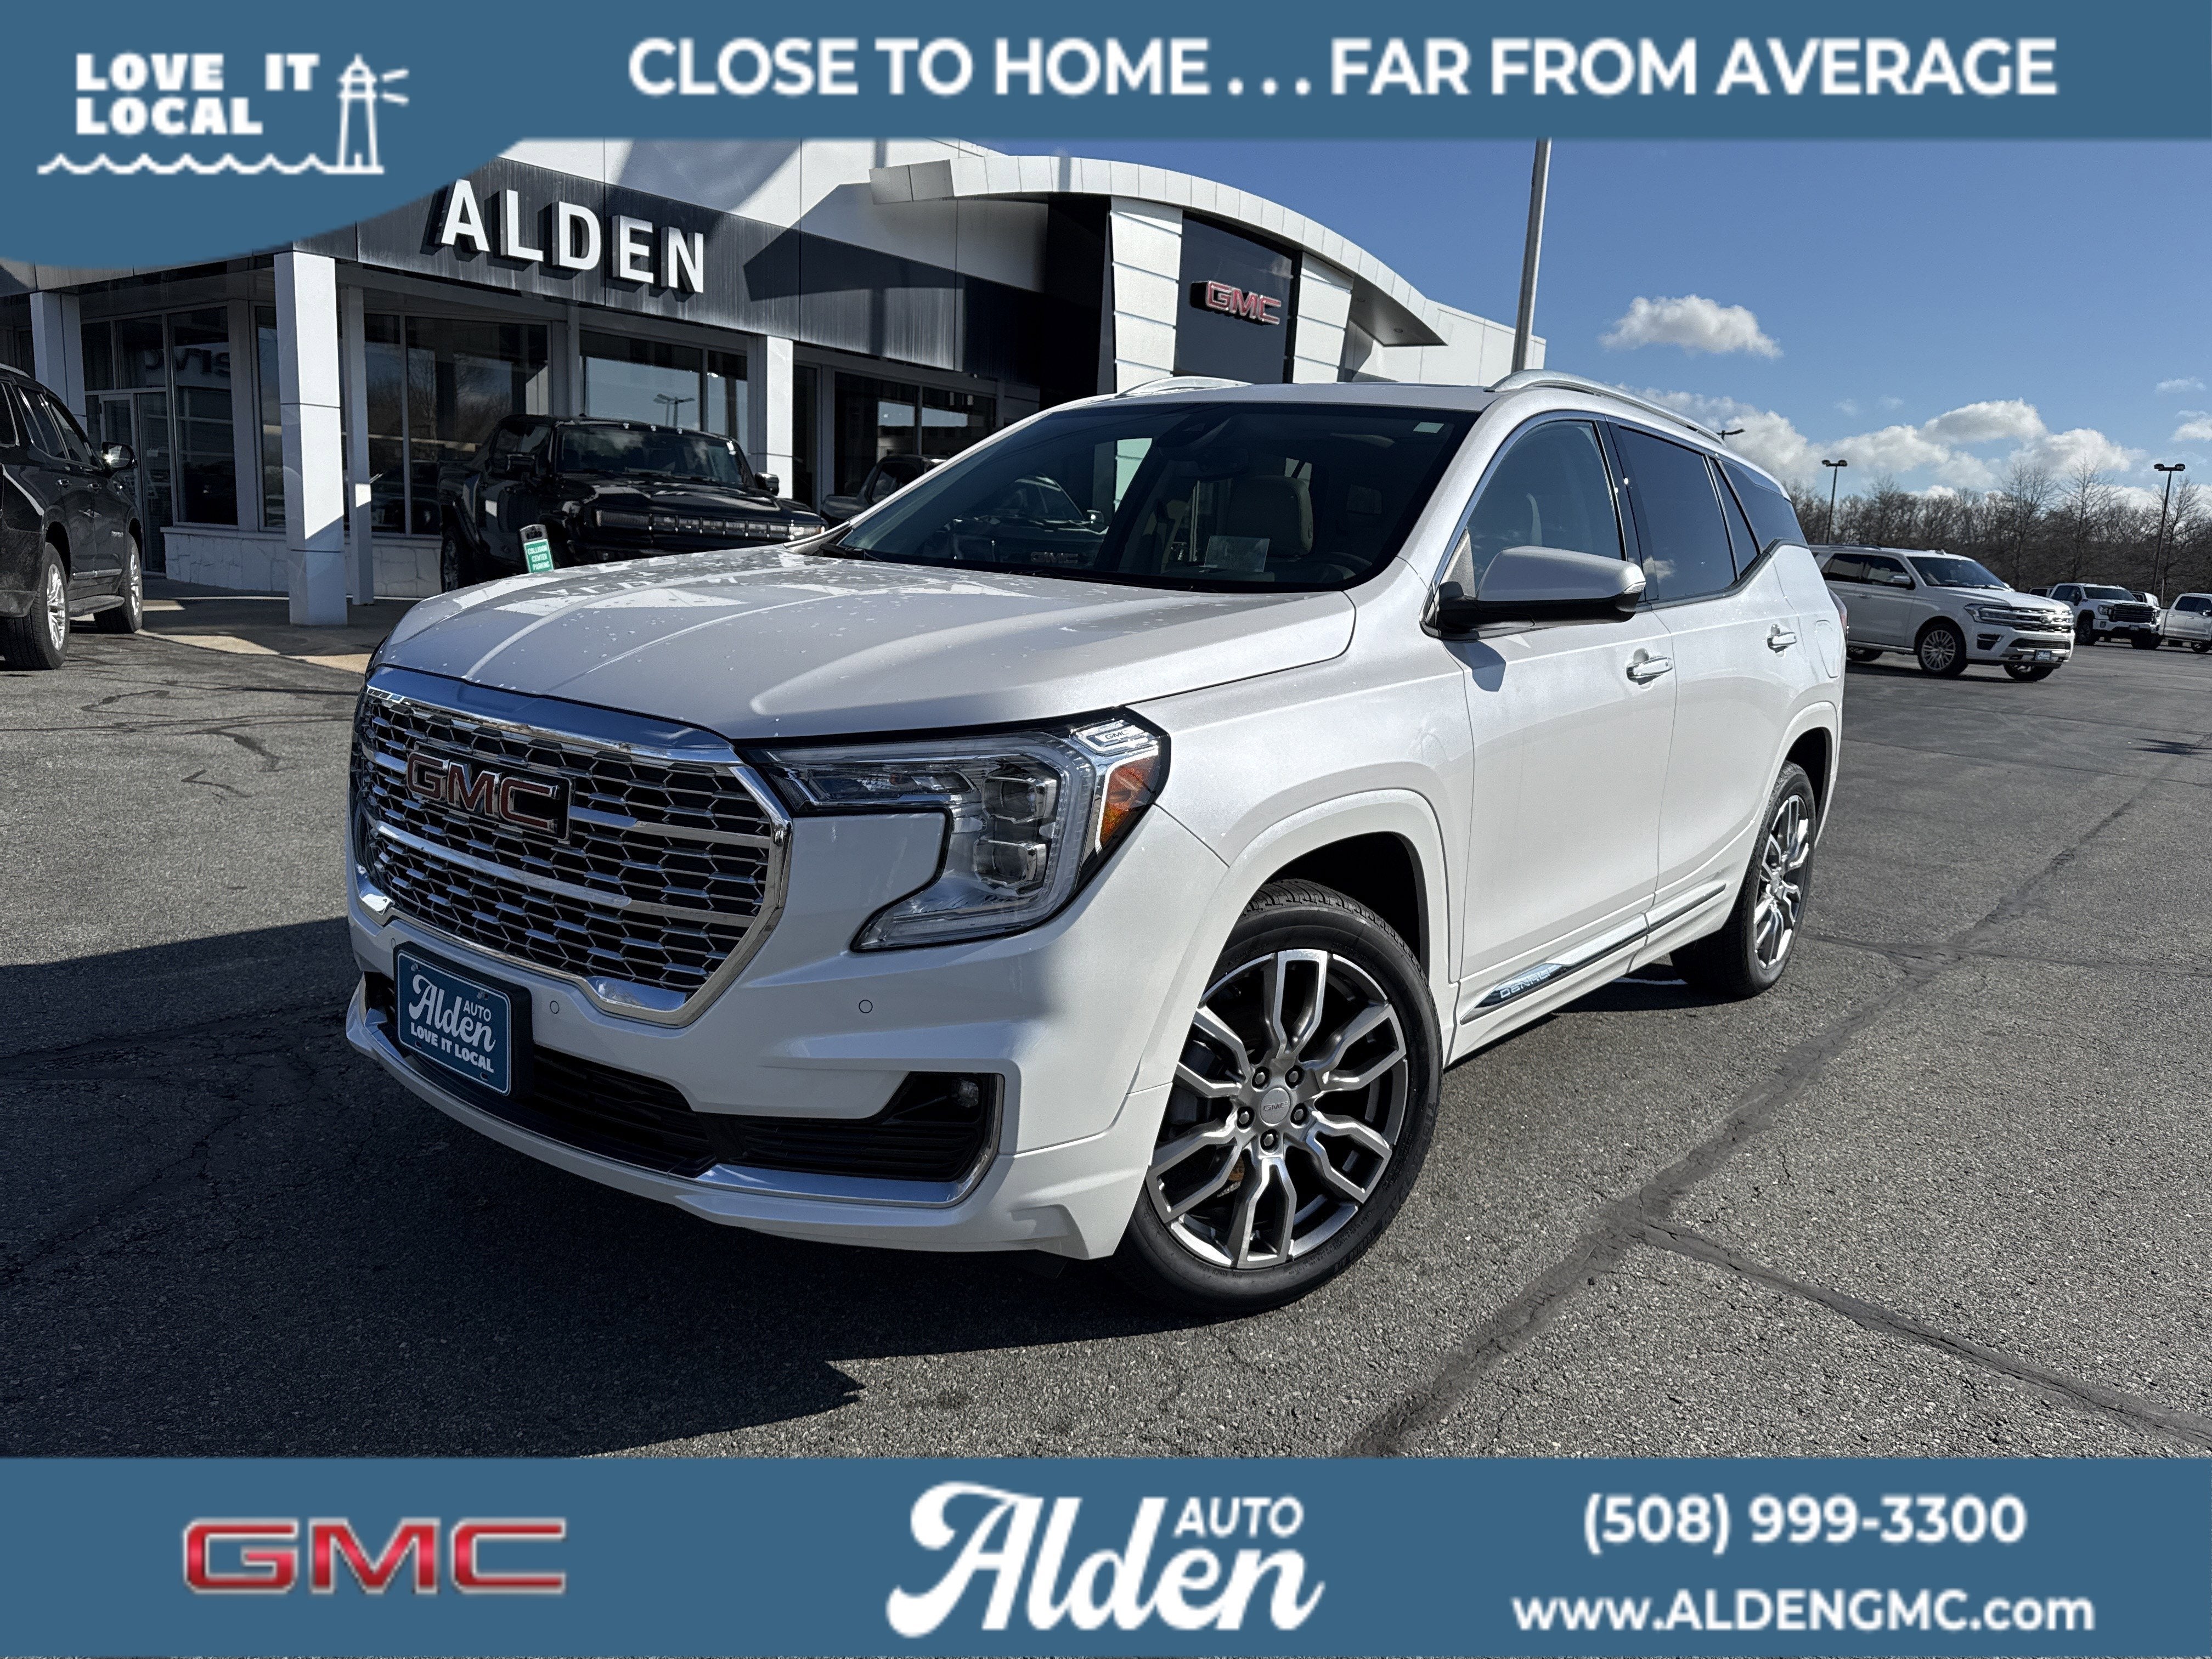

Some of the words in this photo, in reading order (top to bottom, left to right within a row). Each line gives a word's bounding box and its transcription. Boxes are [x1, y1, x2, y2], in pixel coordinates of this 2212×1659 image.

[441, 178, 704, 293] ALDEN
[1205, 280, 1282, 325] GMC
[531, 553, 548, 562] CENTER
[1030, 551, 1078, 563] GMC
[1105, 730, 1130, 740] GMC
[407, 752, 558, 833] GMC
[1499, 968, 1551, 998] DENALI
[409, 974, 496, 1052] Alden
[463, 1000, 492, 1022] AUTO
[410, 1022, 438, 1047] LOVE
[441, 1036, 453, 1053] IT
[455, 1043, 494, 1074] LOCAL
[1263, 1101, 1289, 1111] GMC
